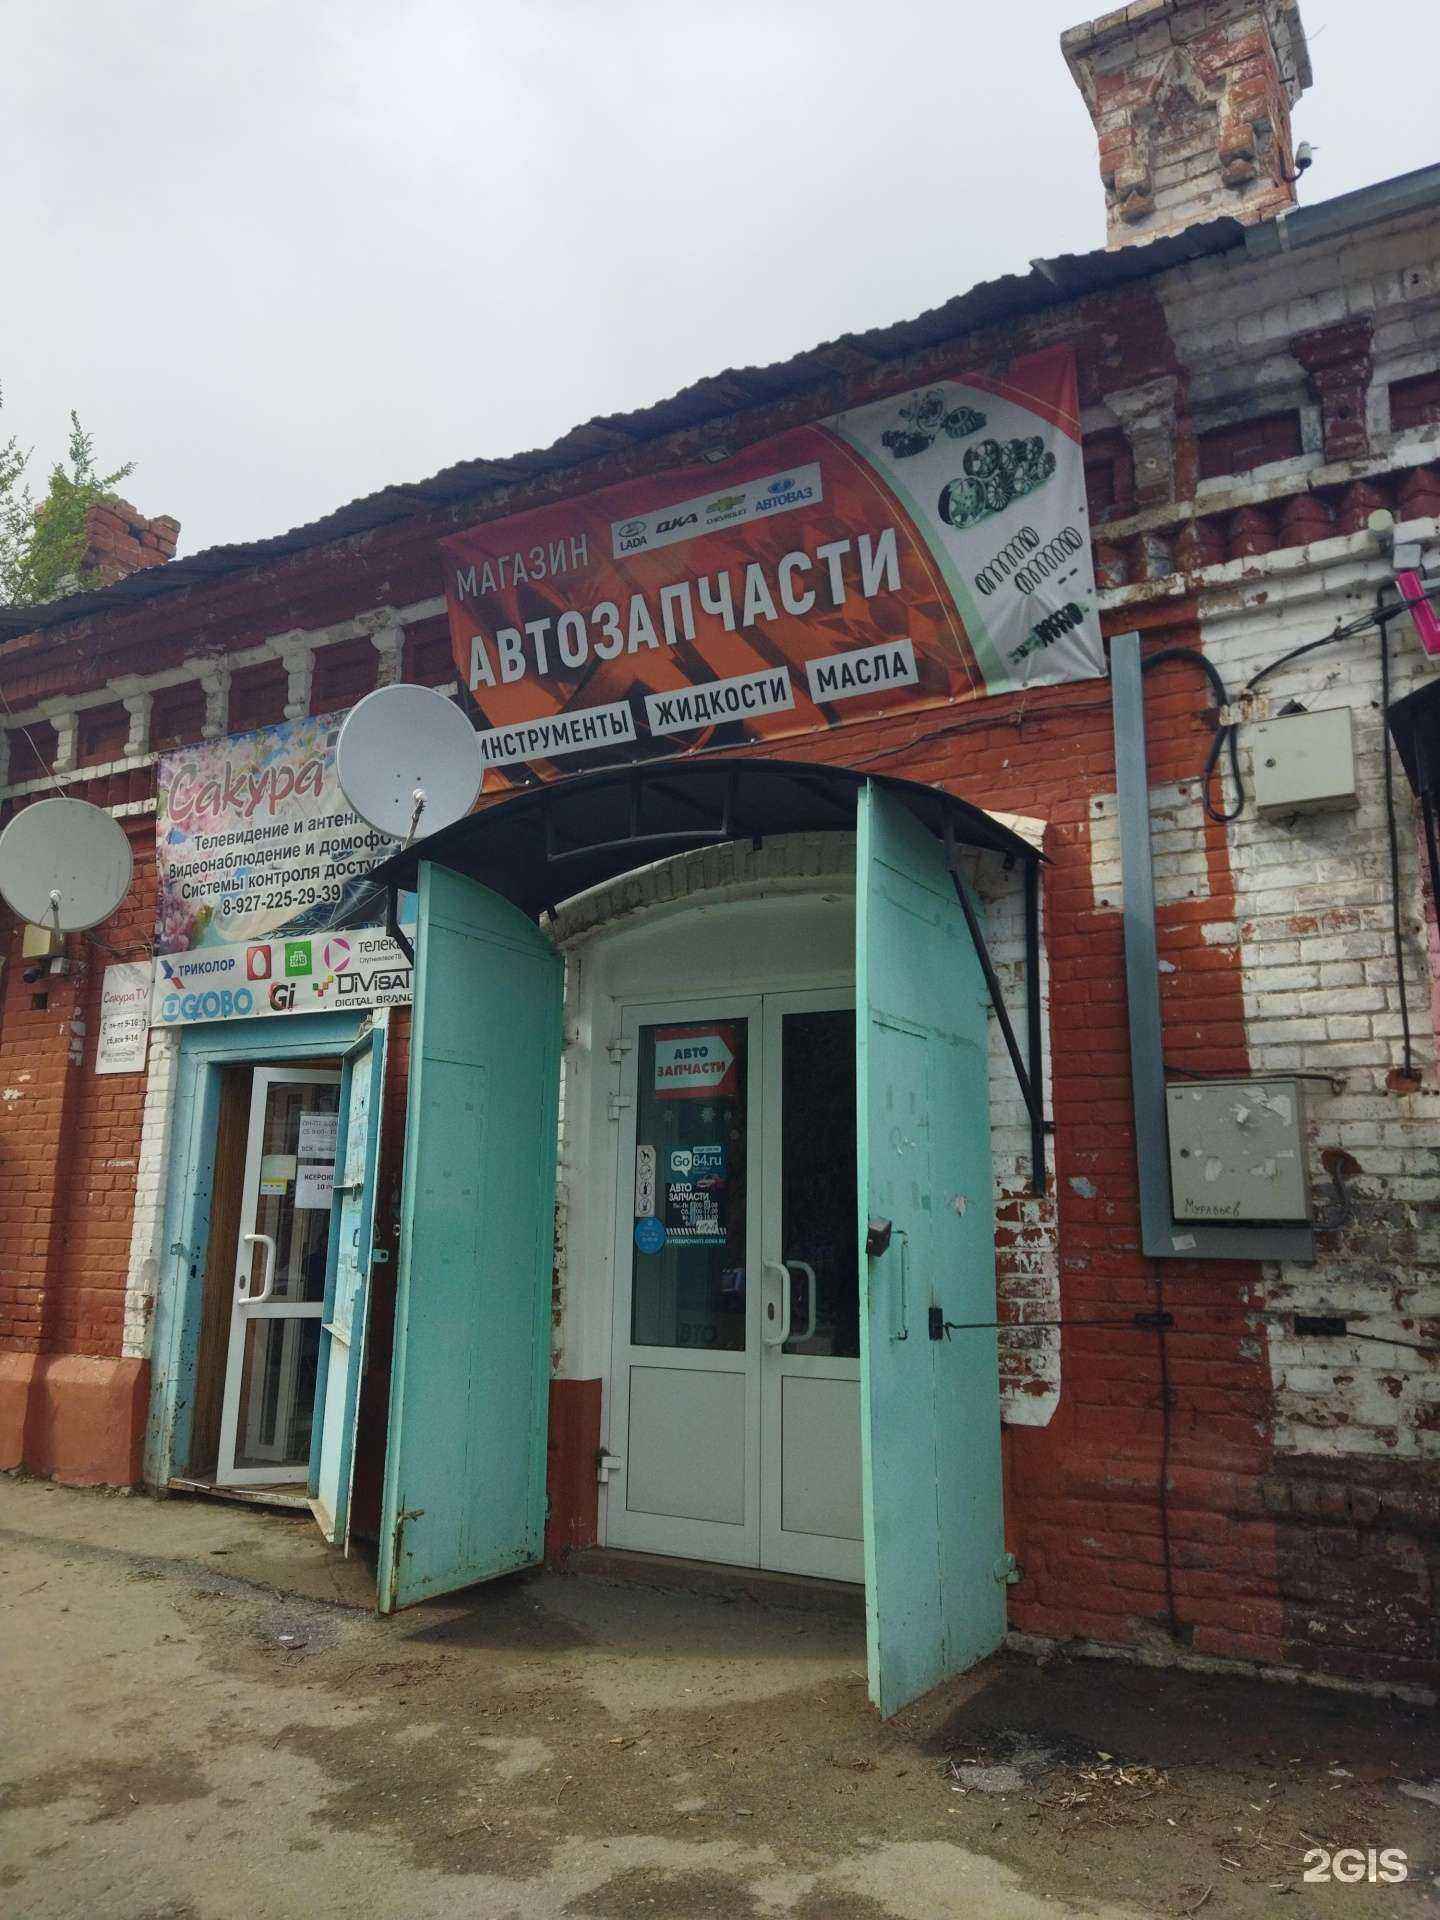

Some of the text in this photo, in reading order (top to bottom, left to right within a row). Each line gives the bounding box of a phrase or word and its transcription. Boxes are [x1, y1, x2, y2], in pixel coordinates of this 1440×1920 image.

[755, 487, 813, 512] АВТОВАЗ
[706, 509, 747, 525] CHEVROLET
[620, 536, 647, 551] LADA
[456, 533, 590, 600] МАГАЗИН
[468, 528, 902, 692] АВТОЗАПЧАСТИ
[654, 677, 787, 726] ЖИДКОСТИ
[816, 650, 909, 693] МАСЛА
[168, 758, 324, 822] Сакура
[194, 812, 363, 851] Телевидение и антен
[169, 830, 393, 880] Видеонаблюдение и домофо
[181, 875, 244, 899] Системы
[248, 864, 320, 887] контроля
[223, 884, 341, 916] 8-927-225-29-39
[178, 958, 236, 977] ТРИКОЛОР
[104, 988, 149, 1005] Сакура TV
[270, 982, 297, 1011] Gi
[335, 997, 372, 1007] DIGITAL
[674, 1046, 708, 1060] АВТО
[657, 1061, 726, 1078] ЗАПЧАСТИ
[669, 1193, 709, 1201] ЗАПЧАСТИ
[670, 1183, 692, 1192] АВТО
